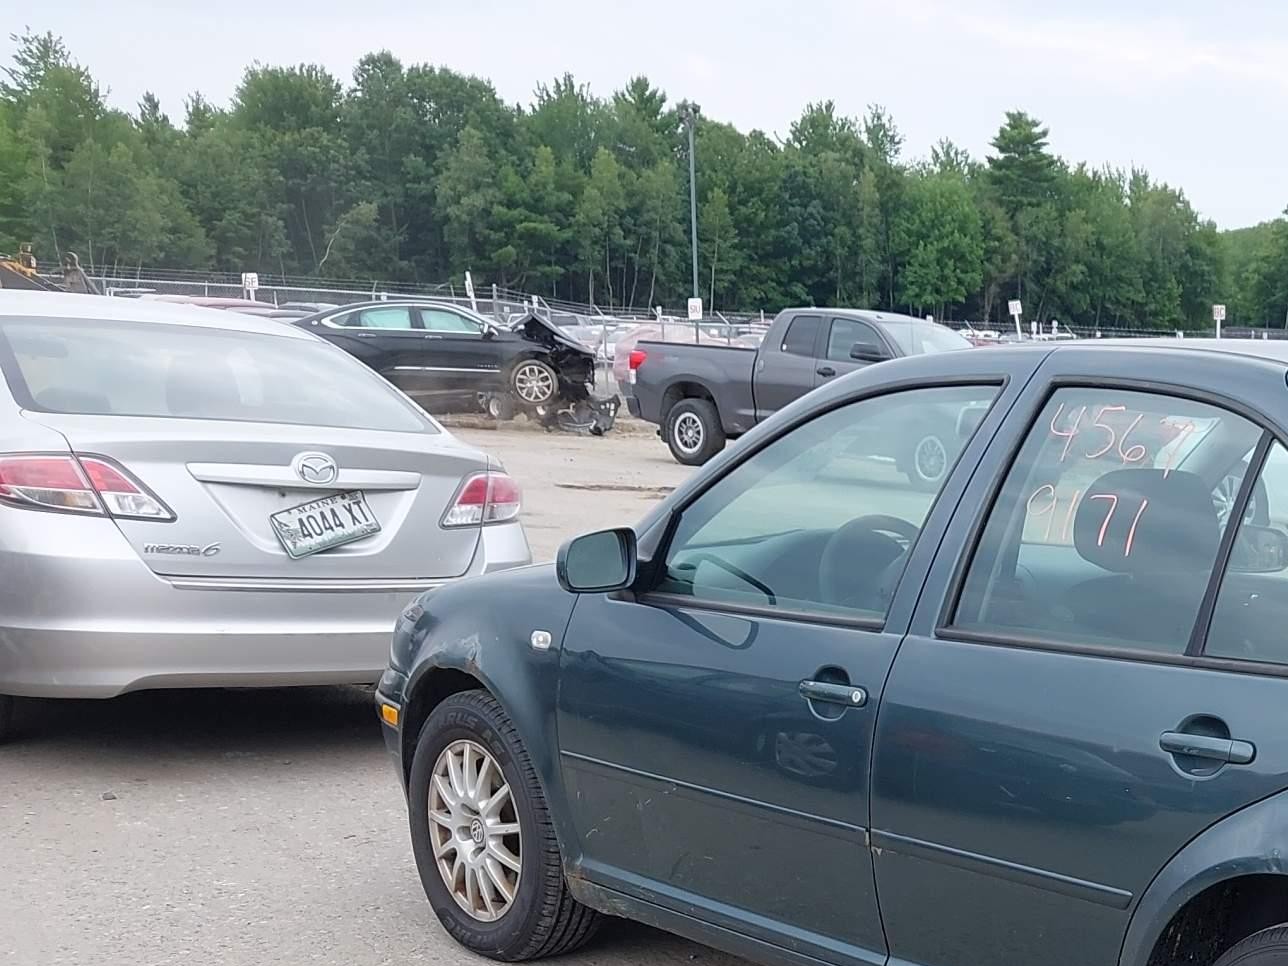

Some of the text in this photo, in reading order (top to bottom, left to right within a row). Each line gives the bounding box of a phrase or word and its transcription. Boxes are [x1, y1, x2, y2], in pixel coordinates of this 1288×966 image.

[296, 498, 338, 514] MAINE
[297, 500, 369, 539] 4044 XT
[1027, 484, 1149, 557] 9171
